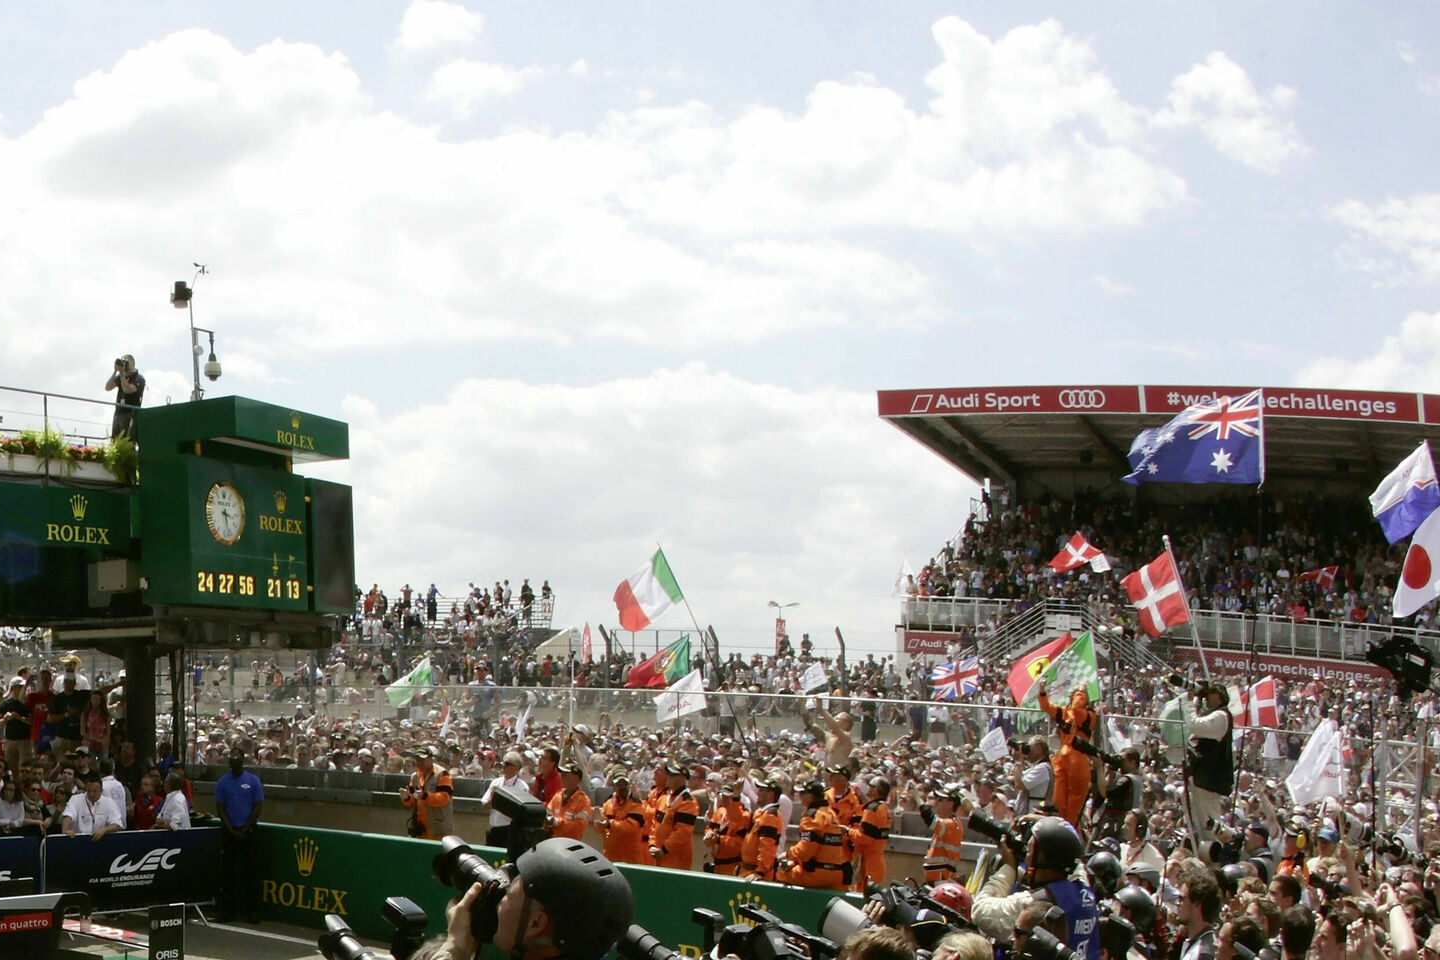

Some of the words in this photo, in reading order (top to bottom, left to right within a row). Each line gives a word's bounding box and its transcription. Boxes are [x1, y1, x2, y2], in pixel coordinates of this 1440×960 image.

[935, 392, 979, 409] Audi
[984, 391, 1041, 412] Sport
[276, 429, 315, 450] ROLEX
[46, 523, 110, 546] ROLEX
[259, 514, 303, 535] ROLEX
[197, 571, 214, 593] 24
[218, 573, 234, 595] 27
[239, 575, 254, 596] 56
[267, 578, 281, 598] 21
[286, 580, 300, 600] 13
[920, 639, 942, 648] Audi
[109, 847, 181, 874] WEC
[98, 876, 119, 884] WORLD
[119, 873, 155, 882] ENDURANCE
[111, 879, 153, 888] CHAMPIONSHIP
[262, 879, 349, 917] ROLEX
[9, 918, 48, 932] quattro
[160, 918, 182, 928] BOSCH
[155, 949, 179, 960] ORIS
